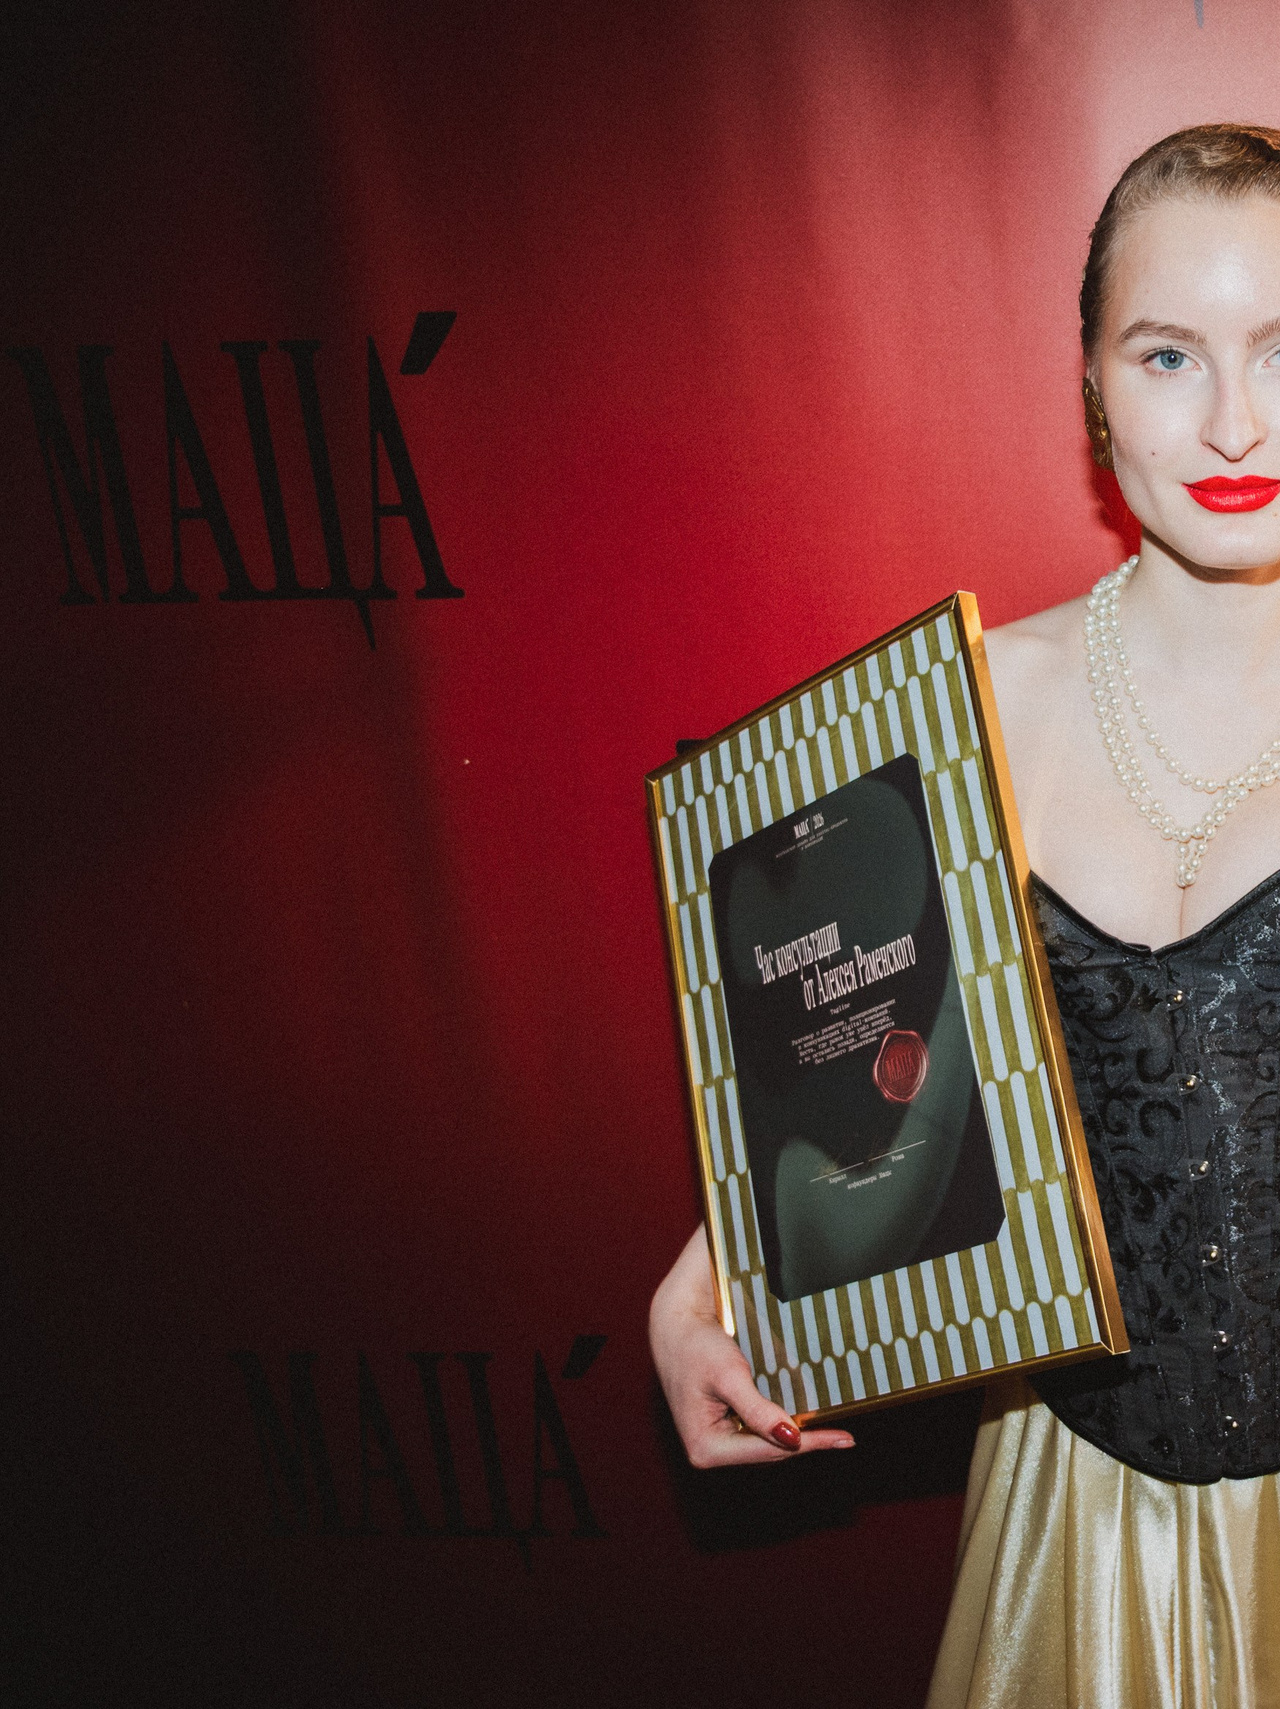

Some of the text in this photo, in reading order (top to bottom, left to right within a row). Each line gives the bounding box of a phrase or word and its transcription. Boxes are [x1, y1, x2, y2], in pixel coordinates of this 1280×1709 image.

[754, 921, 842, 985] Час консультации
[803, 934, 916, 1011] от Алексея Раменского
